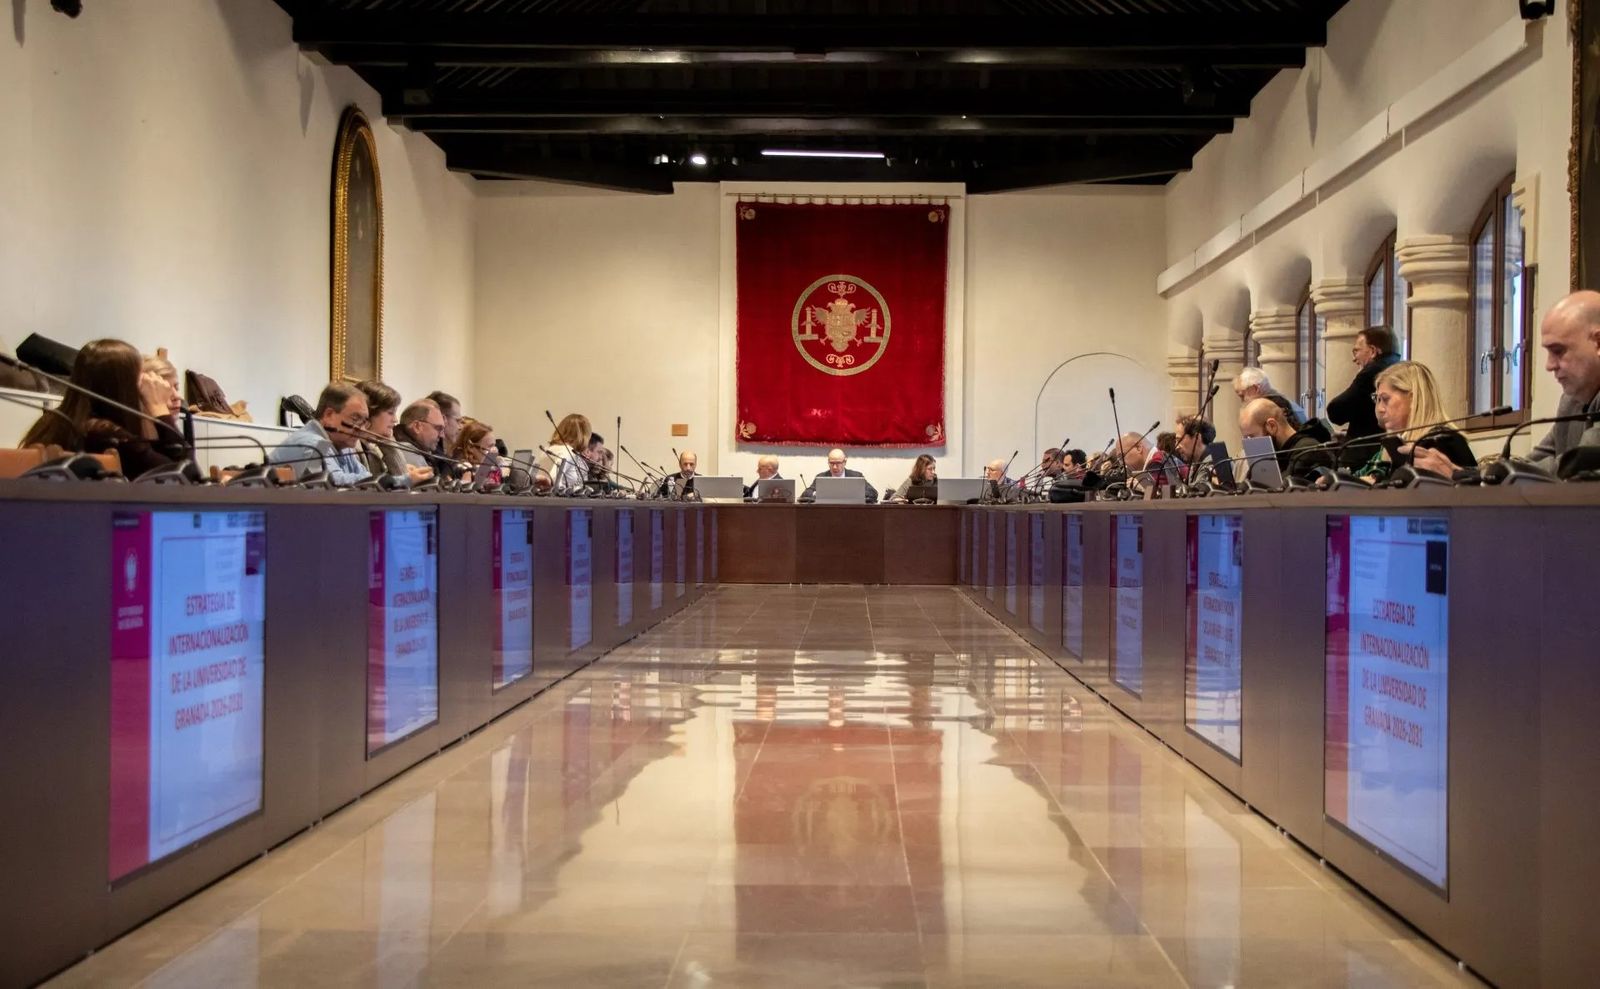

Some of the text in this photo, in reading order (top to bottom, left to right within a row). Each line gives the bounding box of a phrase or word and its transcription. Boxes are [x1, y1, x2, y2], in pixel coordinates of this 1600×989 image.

[1372, 598, 1405, 625] ESTRATEGIA
[1407, 604, 1416, 627] DE
[1360, 631, 1430, 671] INTERNACIONALIZACIÓN
[171, 671, 181, 694] DE
[1418, 685, 1427, 710] DE
